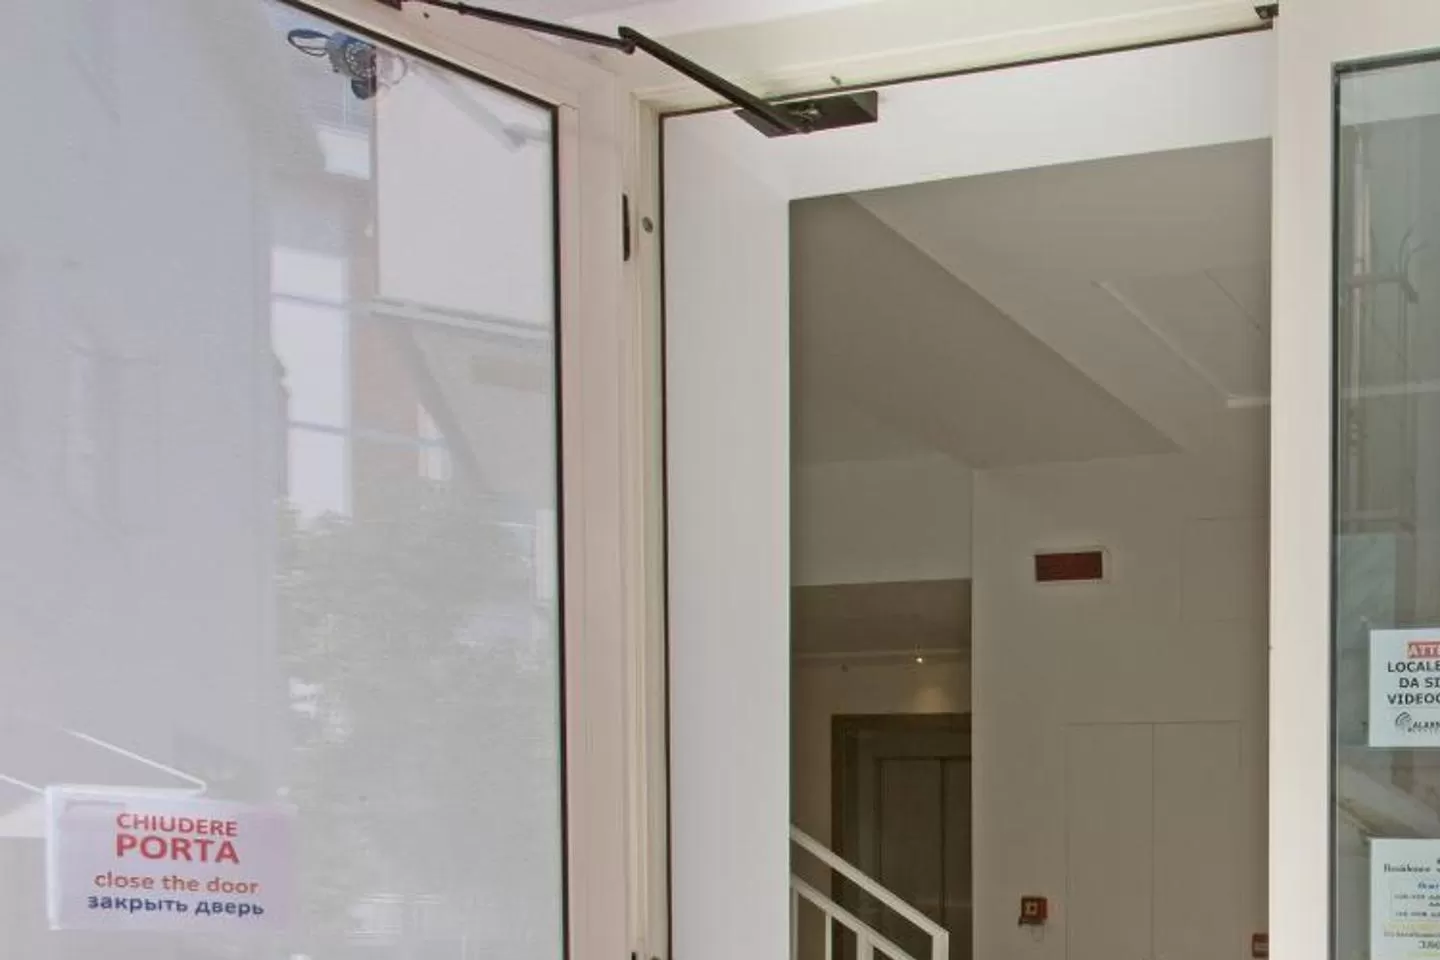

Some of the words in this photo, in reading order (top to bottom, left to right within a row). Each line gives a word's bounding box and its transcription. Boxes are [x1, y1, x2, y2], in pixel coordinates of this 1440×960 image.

[1399, 677, 1419, 689] DA
[116, 813, 238, 837] CHIUDERE
[116, 834, 240, 864] PORTA
[94, 872, 154, 889] close
[162, 875, 200, 892] the
[207, 877, 260, 894] door
[87, 895, 188, 914] закрыть
[195, 900, 264, 917] дверь
